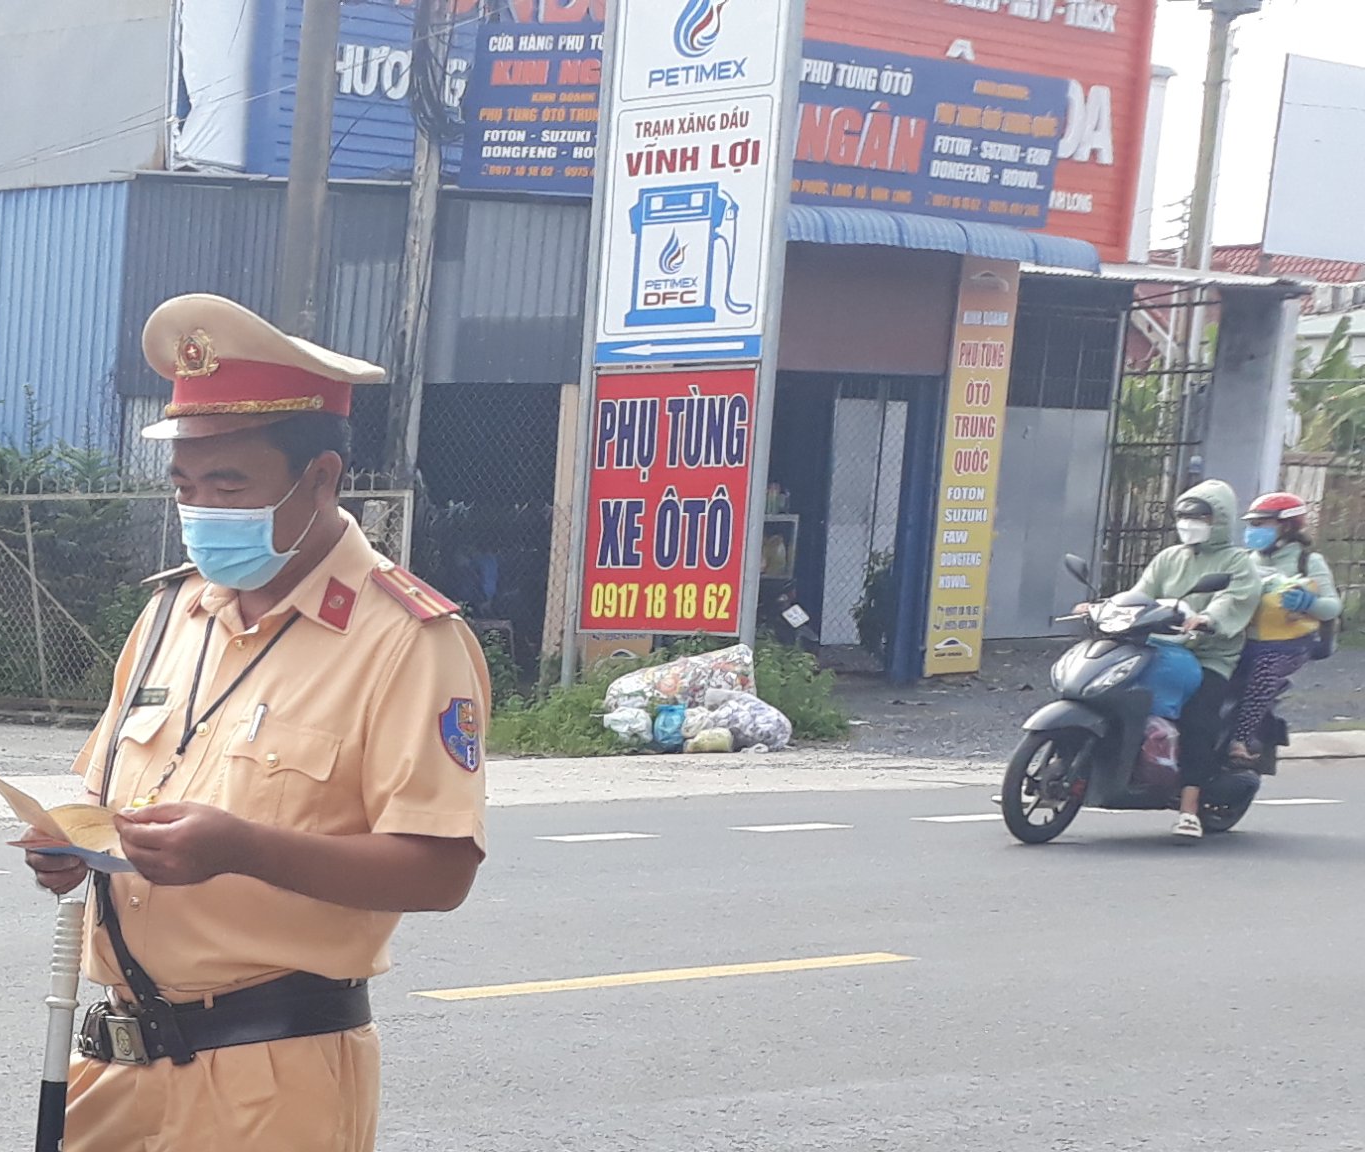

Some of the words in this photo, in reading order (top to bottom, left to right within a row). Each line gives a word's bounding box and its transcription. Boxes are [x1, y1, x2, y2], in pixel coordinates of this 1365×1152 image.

[488, 33, 515, 52] CỬA
[518, 33, 554, 52] HÀNG
[557, 35, 585, 53] PHỤ
[648, 56, 749, 89] PETIMEX
[801, 57, 834, 90] PHỤ
[835, 59, 879, 92] TÙNG
[880, 64, 914, 97] ÔTÔ
[483, 129, 527, 142] FOTON
[540, 129, 592, 143] SUZUKI
[635, 119, 675, 142] TRẠM
[677, 112, 717, 136] XĂNG
[792, 100, 929, 174] NGÂN
[481, 145, 558, 159] DONGFENG
[625, 143, 700, 178] VĨNH
[710, 138, 761, 174] LỢI
[643, 290, 698, 307] DFC
[644, 276, 698, 291] PETIMEX
[980, 337, 1006, 370] TÙNG
[595, 397, 660, 482] PHỤ
[665, 384, 749, 469] TÙNG
[953, 414, 997, 440] TRUNG
[953, 441, 990, 476] QUỐC
[946, 486, 986, 501] FOTON
[596, 498, 646, 570] XE
[653, 485, 734, 570] ÔTÔ
[944, 508, 989, 523] SUZUKI
[942, 530, 969, 544] FAW
[590, 582, 640, 619] 0917
[644, 583, 668, 620] 18
[673, 583, 698, 620] 18
[703, 583, 732, 620] 62
